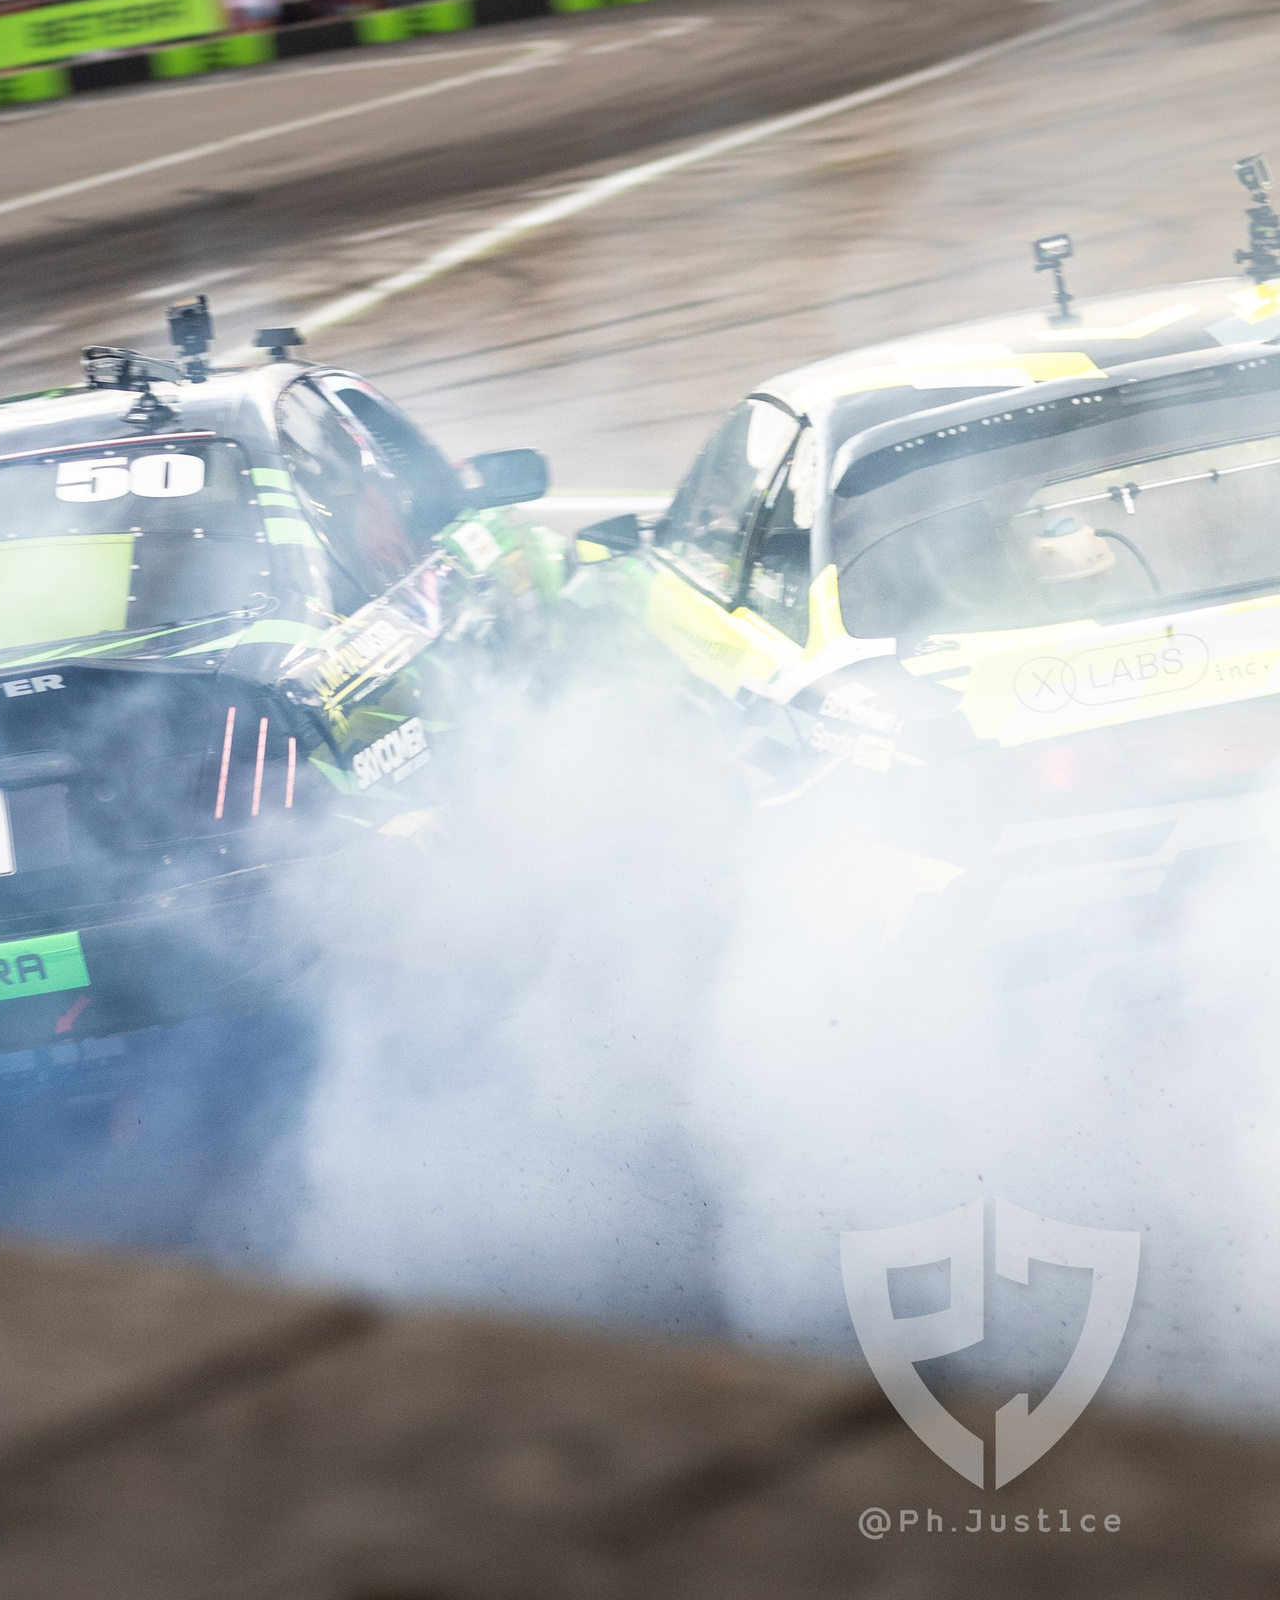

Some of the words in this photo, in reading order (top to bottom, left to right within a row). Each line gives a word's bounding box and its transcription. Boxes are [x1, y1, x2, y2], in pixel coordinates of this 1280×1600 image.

[54, 453, 205, 502] 50
[1088, 647, 1185, 690] LABS
[1215, 663, 1271, 682] inc.
